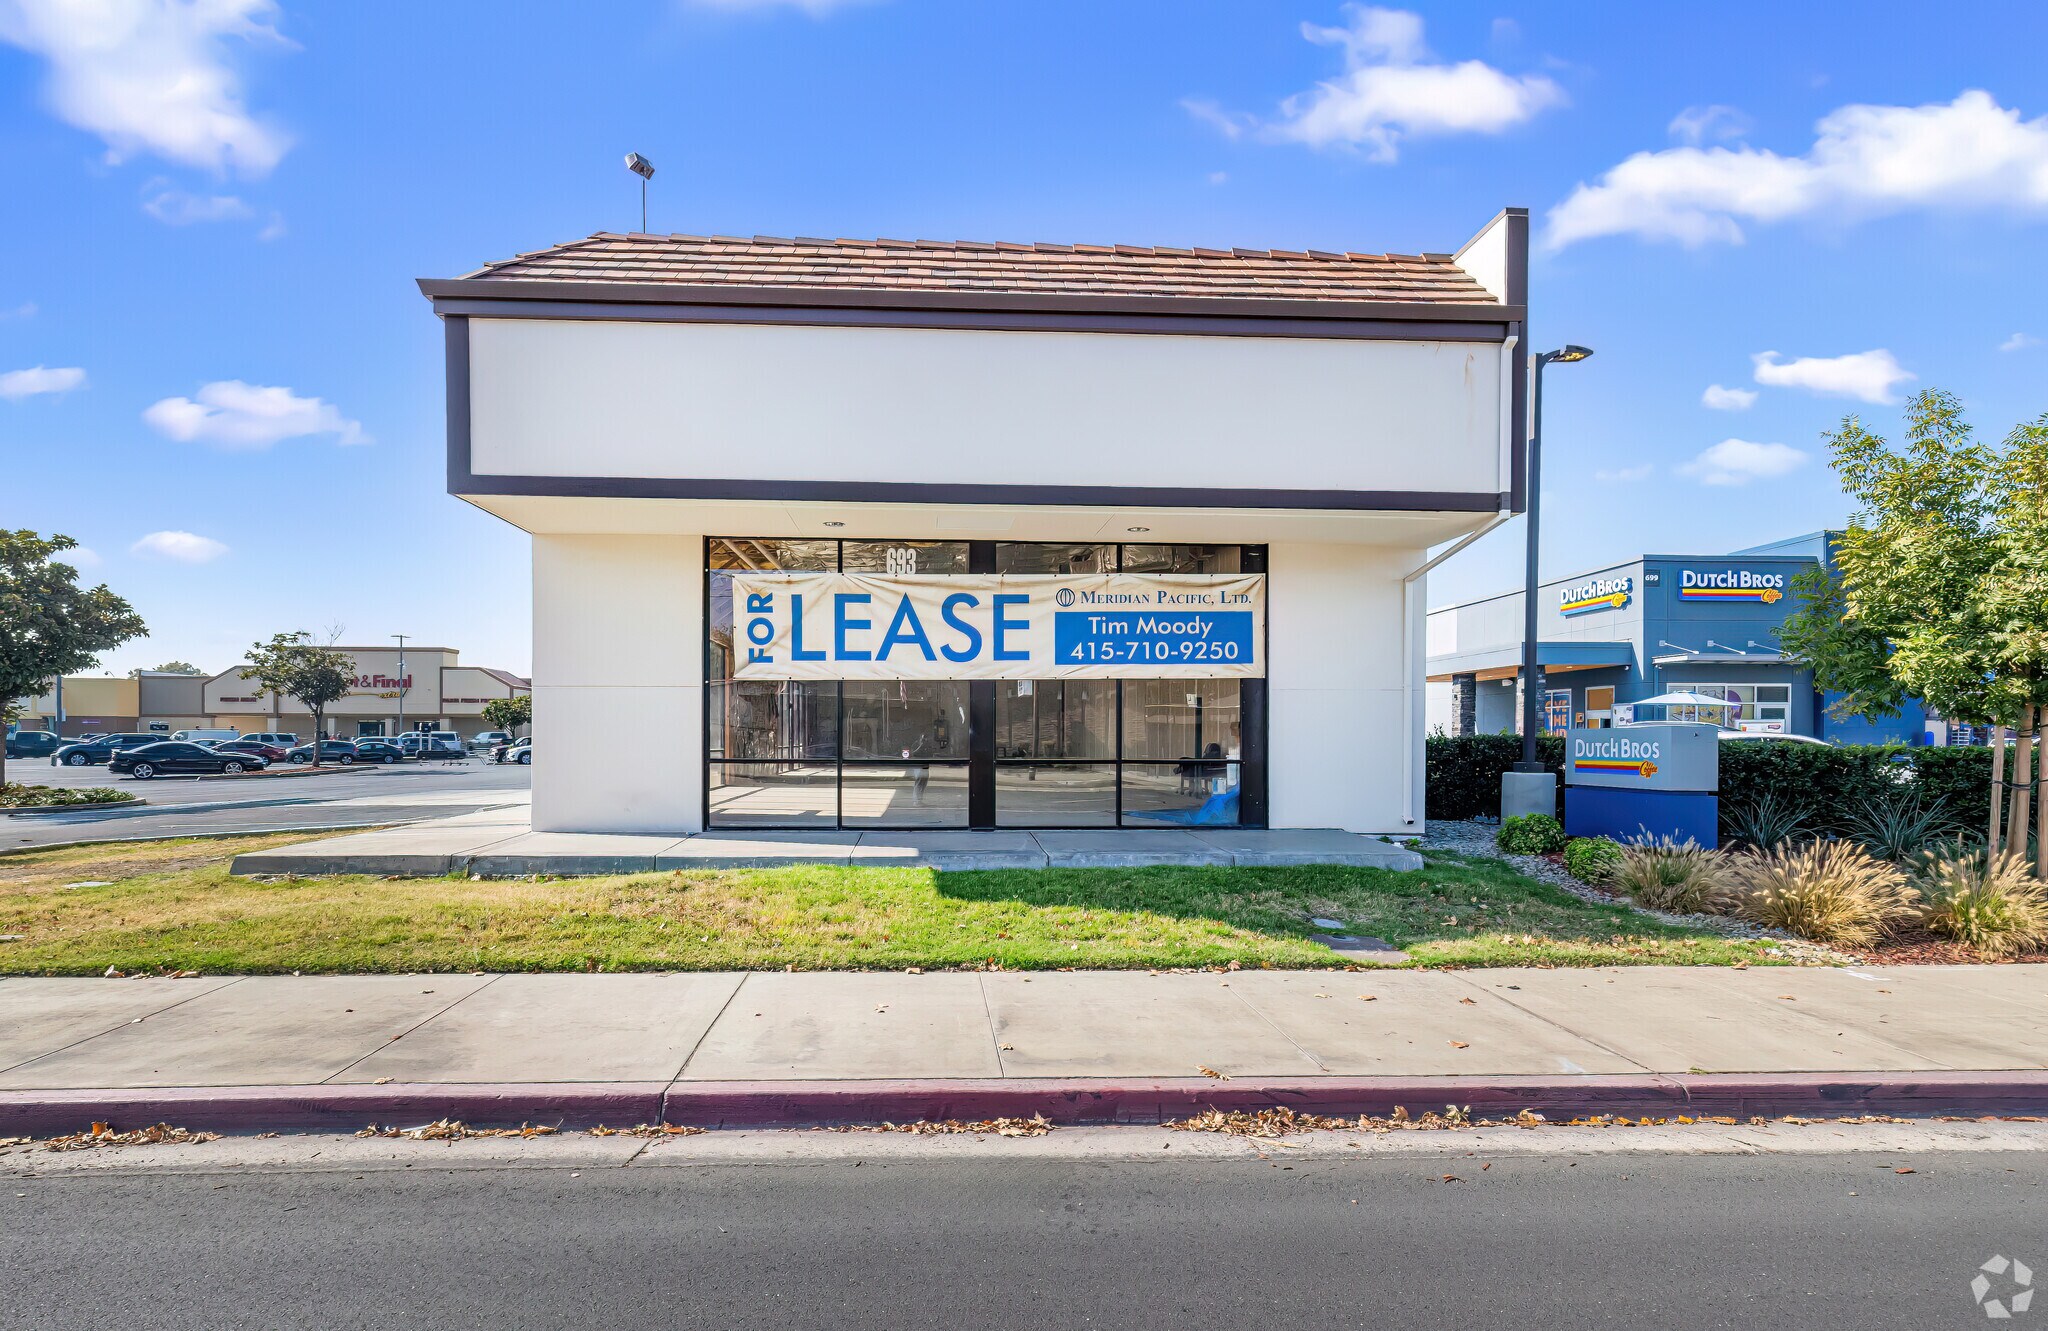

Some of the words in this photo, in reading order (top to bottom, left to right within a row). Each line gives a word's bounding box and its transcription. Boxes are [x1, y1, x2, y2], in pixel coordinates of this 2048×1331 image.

[886, 547, 917, 575] 693
[1080, 590, 1150, 604] MERIDIAN
[1157, 590, 1215, 606] PACIFIC,
[747, 592, 775, 664] FOR
[790, 592, 1030, 663] LEASE
[1087, 616, 1129, 635] Tim
[1136, 615, 1213, 639] Moody
[1070, 641, 1239, 661] 415-710-9250
[373, 674, 412, 688] Final
